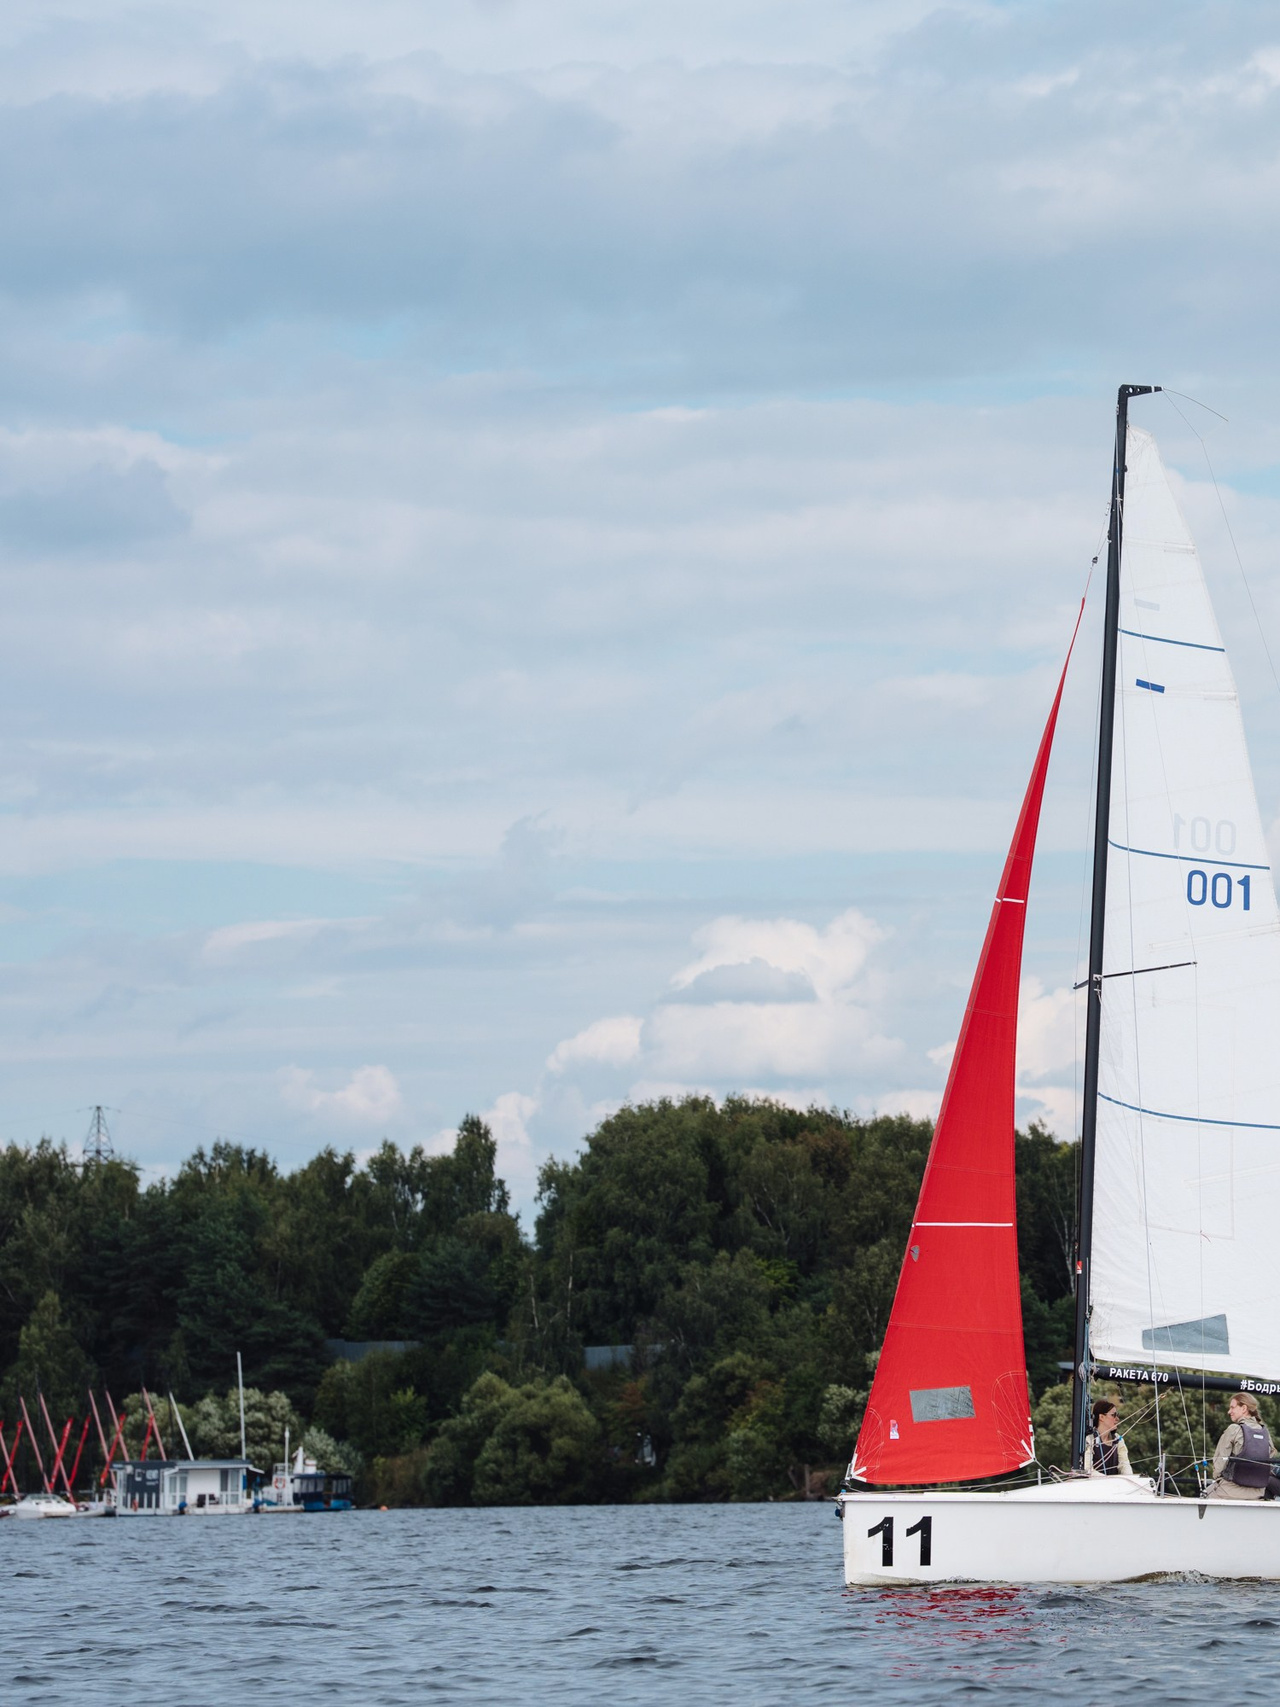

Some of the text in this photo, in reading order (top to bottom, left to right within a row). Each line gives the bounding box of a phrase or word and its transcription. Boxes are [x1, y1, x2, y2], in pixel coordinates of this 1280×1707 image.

[1187, 869, 1250, 911] 001
[1109, 1367, 1169, 1383] РАКЕТА 670
[868, 1516, 932, 1567] 11
